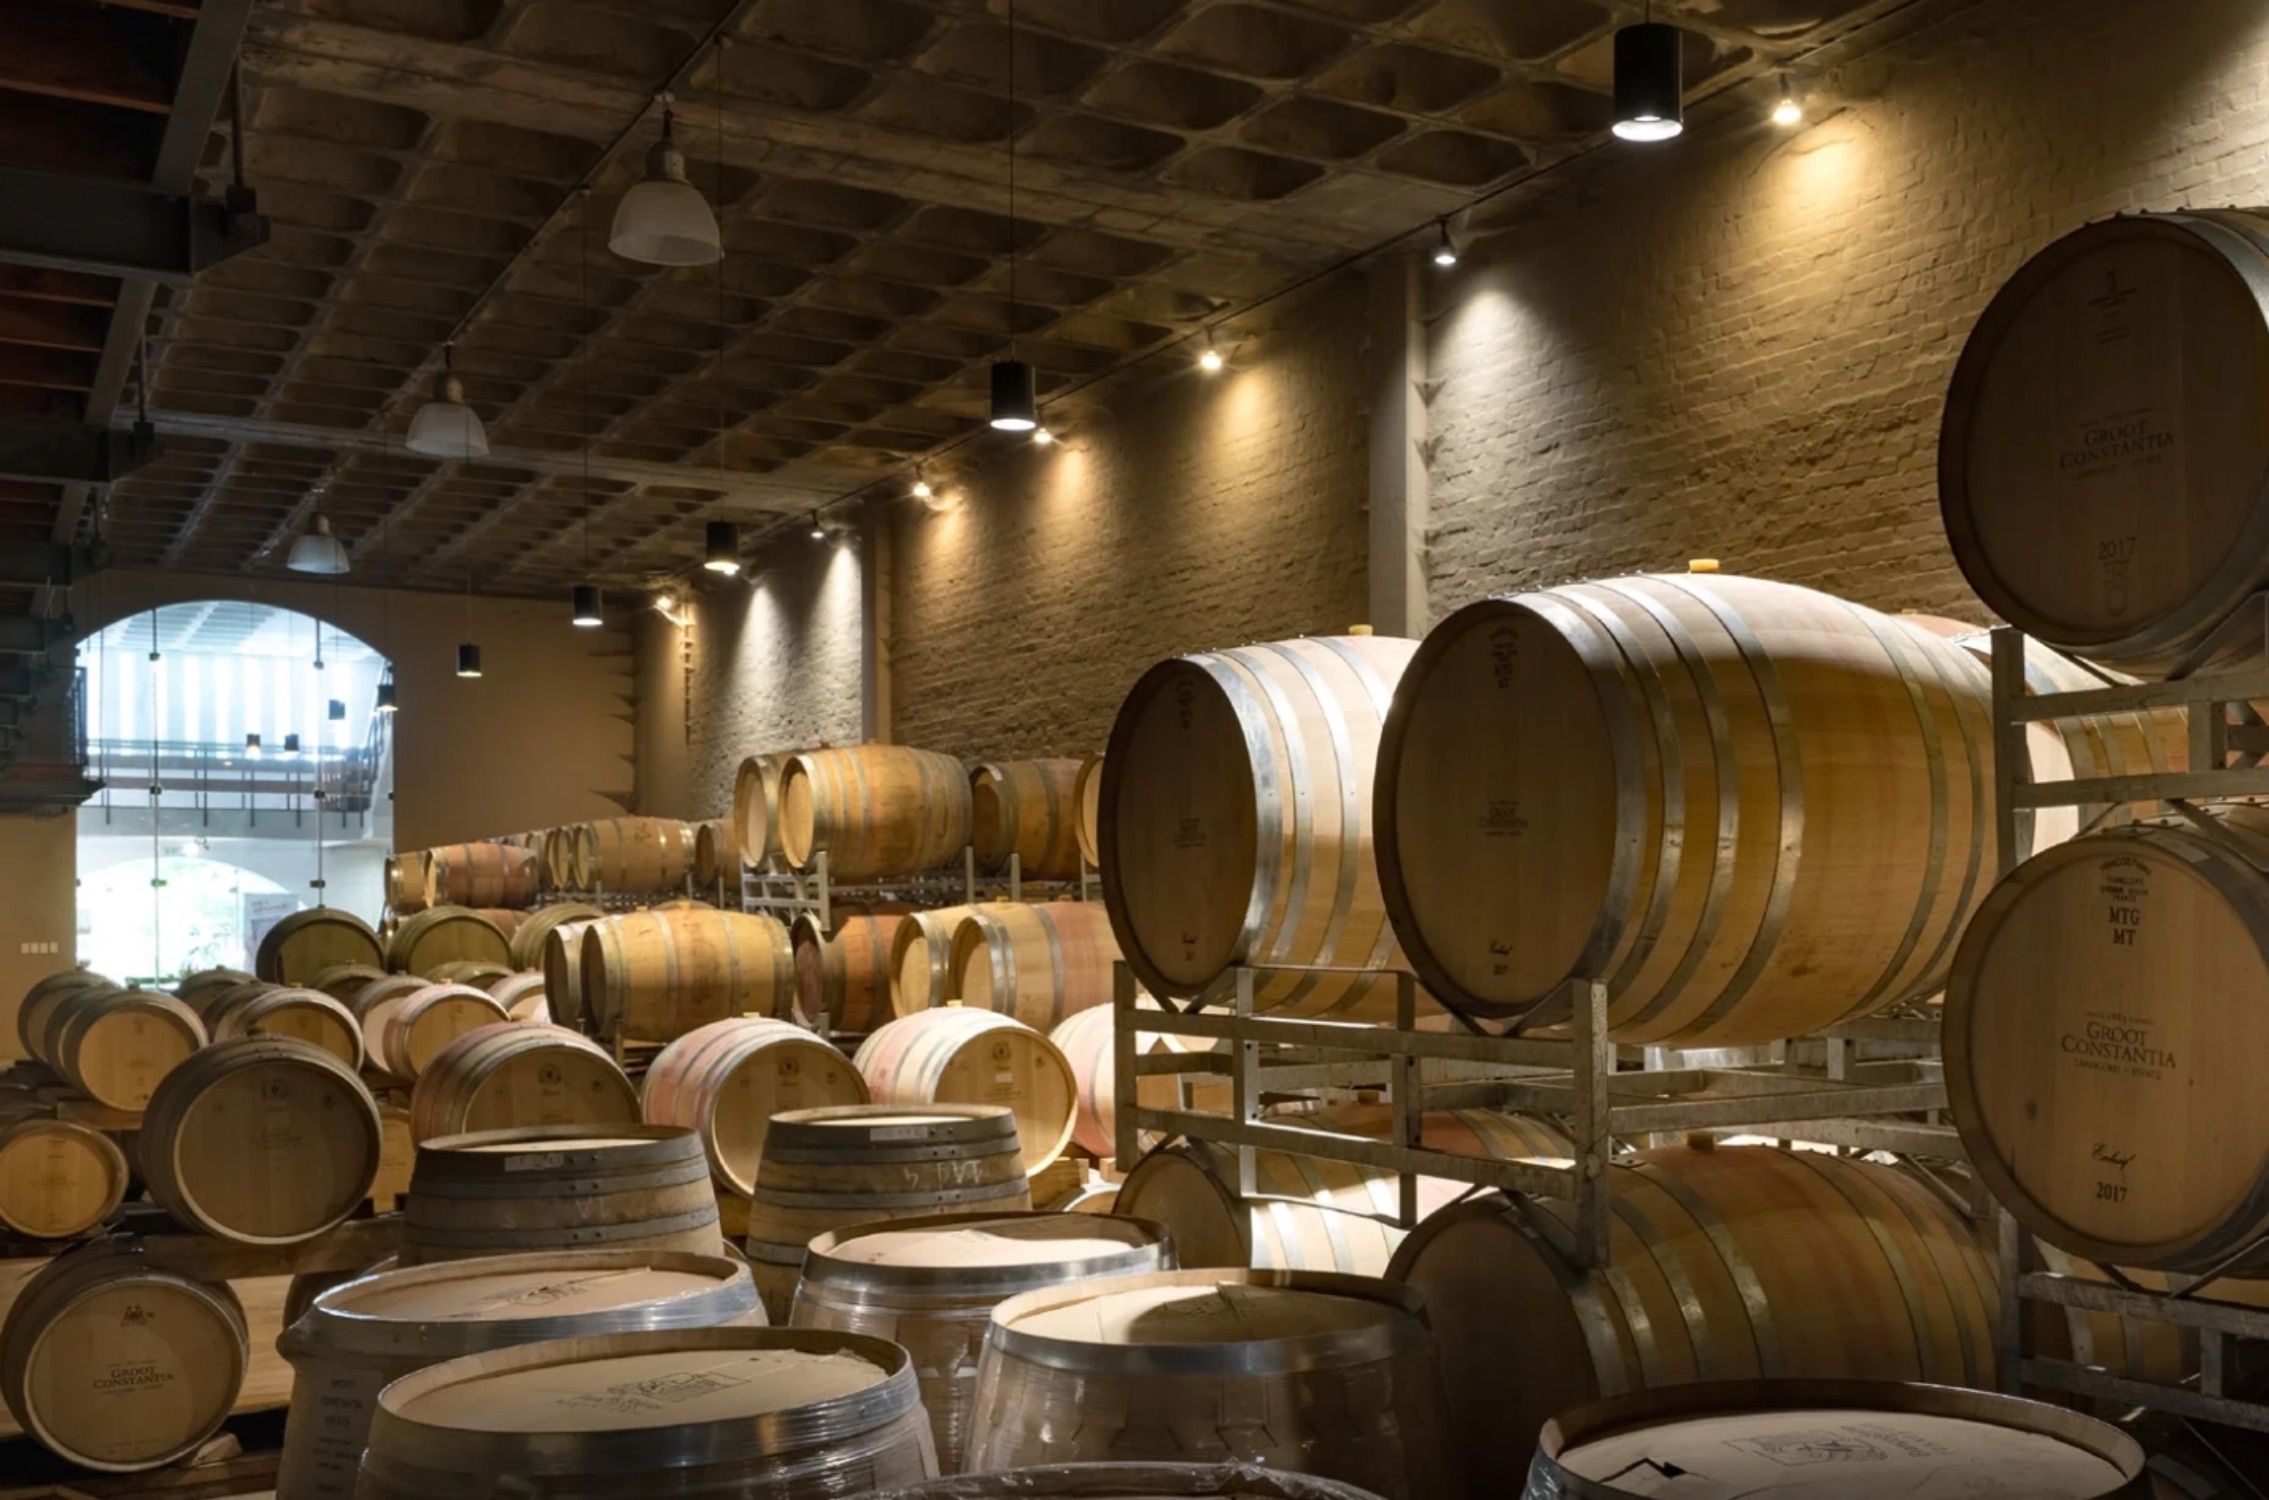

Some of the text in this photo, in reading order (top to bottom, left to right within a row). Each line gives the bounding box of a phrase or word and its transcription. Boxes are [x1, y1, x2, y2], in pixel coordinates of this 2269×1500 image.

[2084, 419, 2148, 447] GROOT
[2059, 431, 2175, 470] CONSTANTIA
[2097, 536, 2137, 561] 2017
[2108, 906, 2140, 925] MTG
[2113, 928, 2136, 945] MT
[2086, 1020, 2149, 1046] GROOT
[2061, 1034, 2177, 1069] CONSTANTIA
[2095, 1181, 2128, 1203] 2017
[92, 1372, 175, 1390] CONSTANTIA
[110, 1365, 156, 1379] GROOT
